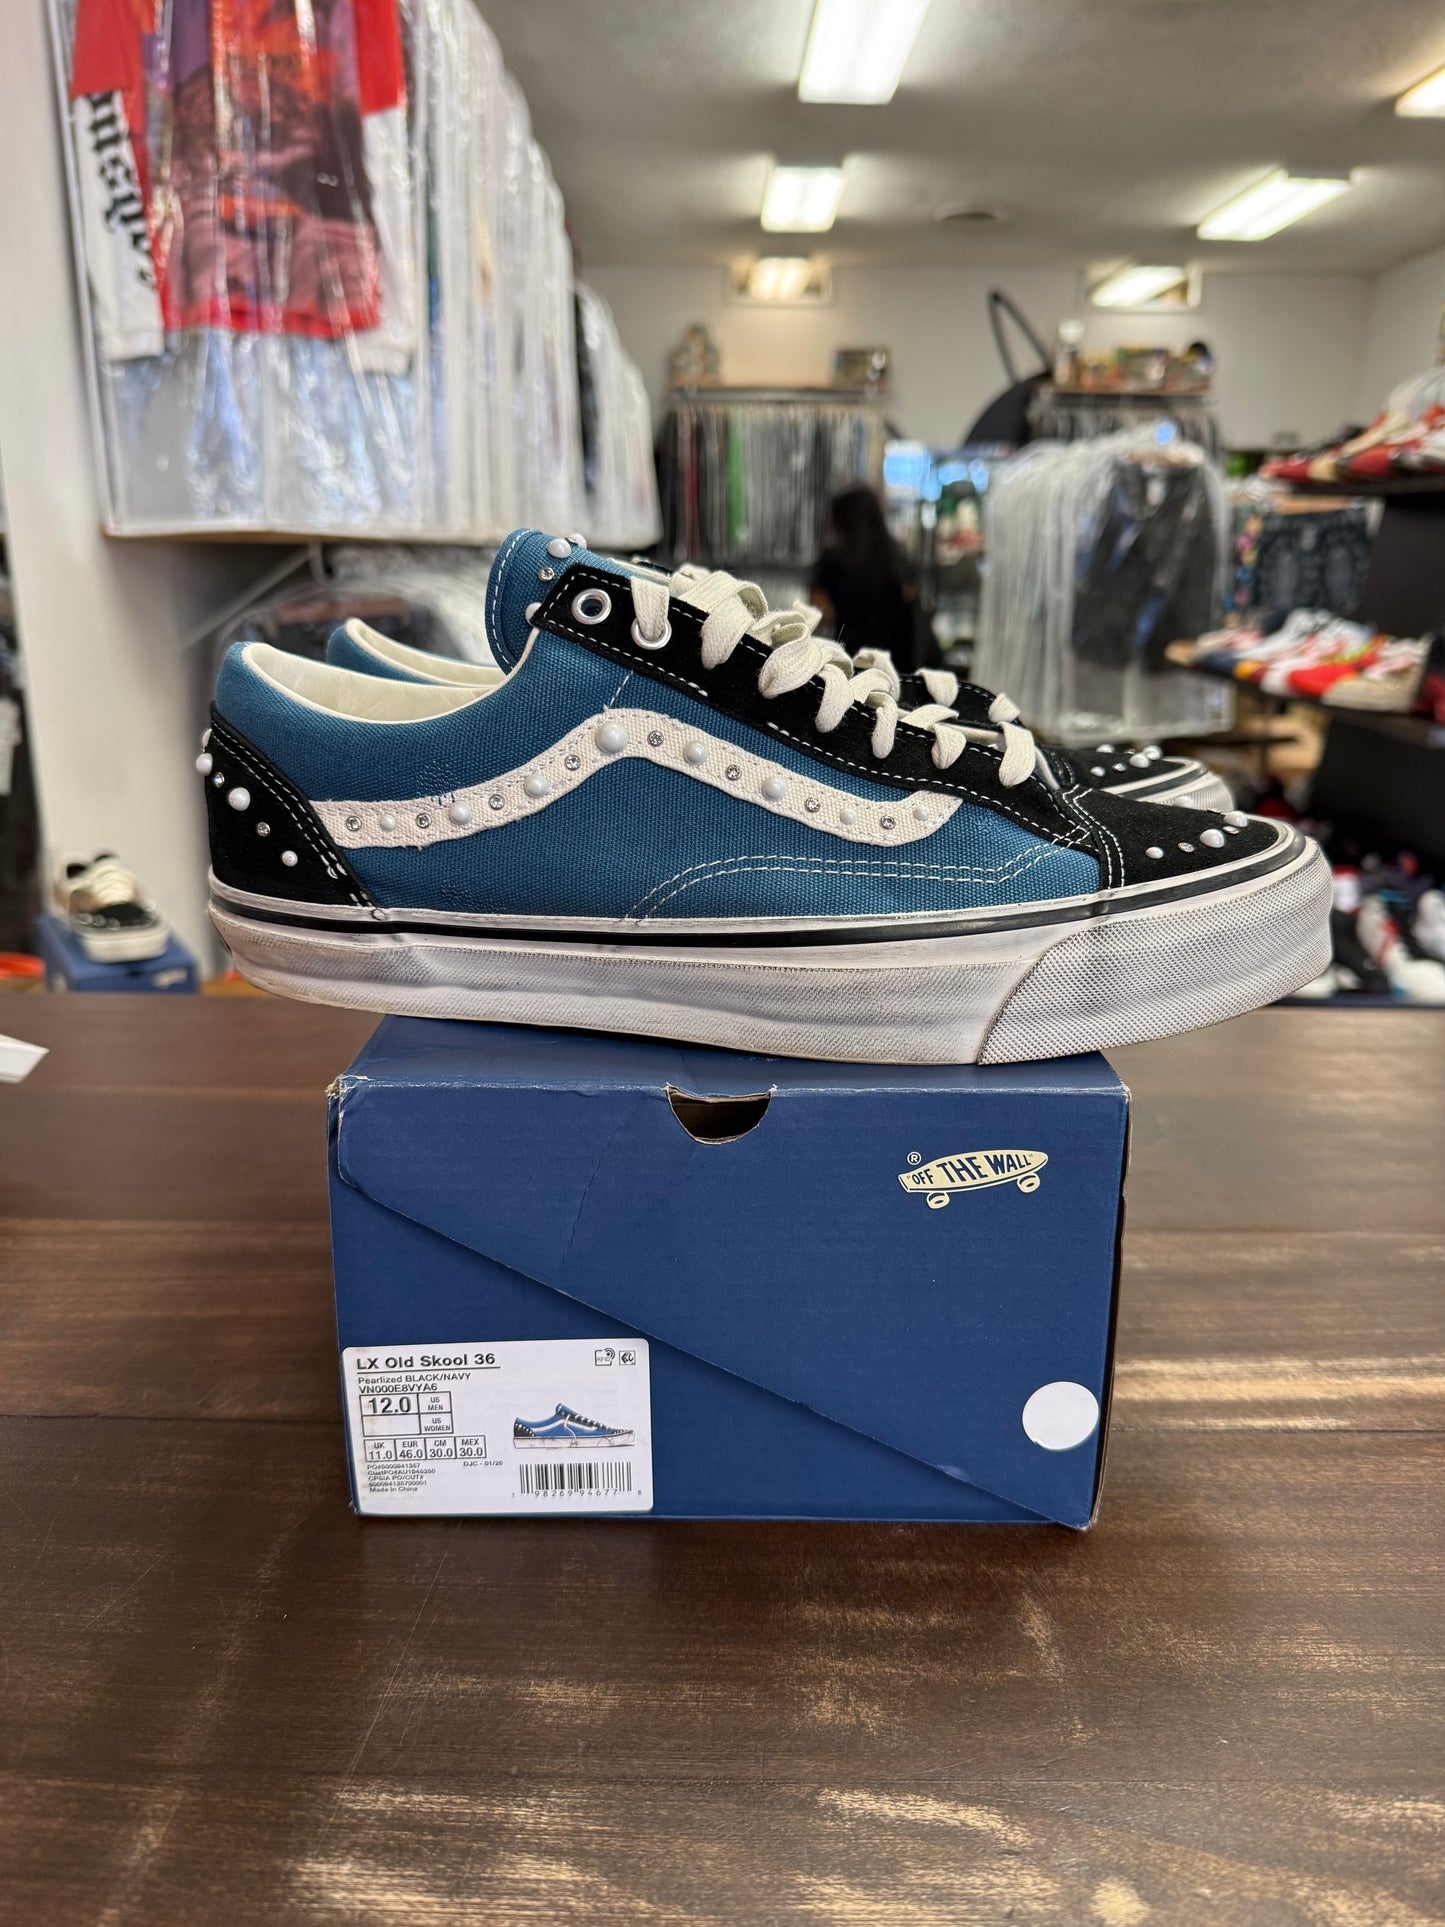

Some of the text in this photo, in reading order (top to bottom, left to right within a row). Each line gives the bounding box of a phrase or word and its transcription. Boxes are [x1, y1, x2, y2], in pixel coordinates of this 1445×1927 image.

[936, 1156, 988, 1183] THE
[356, 1353, 496, 1370] LX Old Skool 36
[358, 1372, 471, 1385] Pearlized BLACK/NAVY
[359, 1383, 438, 1394] VN000E8VYA6
[368, 1396, 412, 1414] 12.0
[430, 1396, 440, 1404] US
[424, 1424, 451, 1432] WOMEN
[461, 1438, 480, 1446] MEX
[369, 1447, 483, 1460] 11.0 46.0 30.0 30.0
